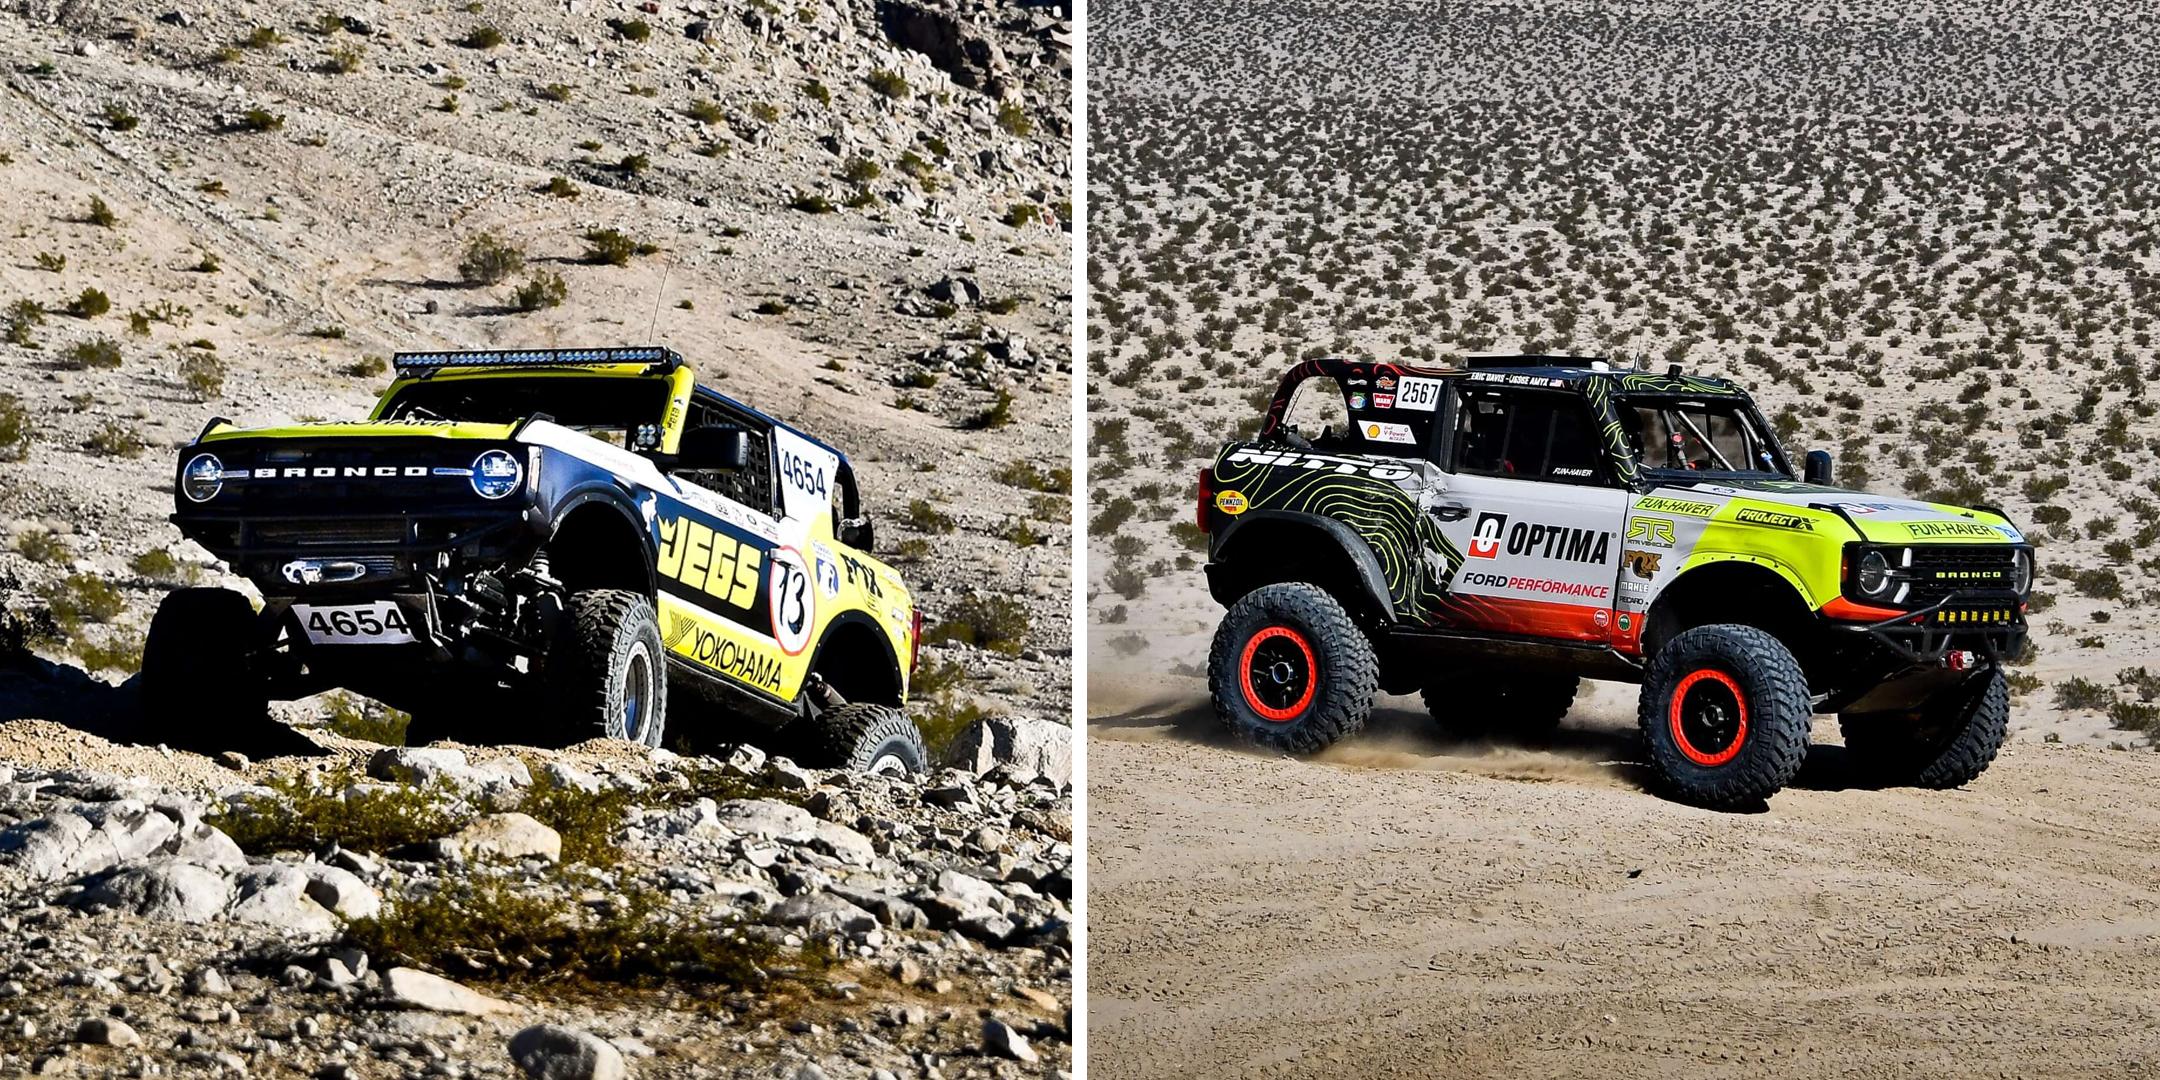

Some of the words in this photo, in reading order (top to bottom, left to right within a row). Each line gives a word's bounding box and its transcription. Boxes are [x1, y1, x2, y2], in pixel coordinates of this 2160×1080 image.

[1471, 372, 1486, 381] ERIC
[1402, 381, 1438, 405] 2567
[254, 467, 428, 478] BRONCO
[783, 451, 826, 500] 4654
[1227, 448, 1413, 481] NITTO
[1636, 497, 1714, 517] FUN-HAVER
[1738, 509, 1798, 527] PROJECT
[1908, 521, 1994, 537] FUN-HAVER
[1507, 521, 1610, 565] OPTIMA
[657, 516, 761, 611] JEGS
[840, 552, 883, 599] FOX
[1623, 550, 1662, 581] FOX
[1936, 571, 2001, 579] BRONCO
[777, 560, 806, 635] 13
[1463, 572, 1508, 588] FORD
[1508, 577, 1610, 599] PERFORMANCE
[1620, 581, 1649, 593] MAHLE
[308, 609, 411, 637] 4654
[691, 627, 783, 692] YOKOHAMA
